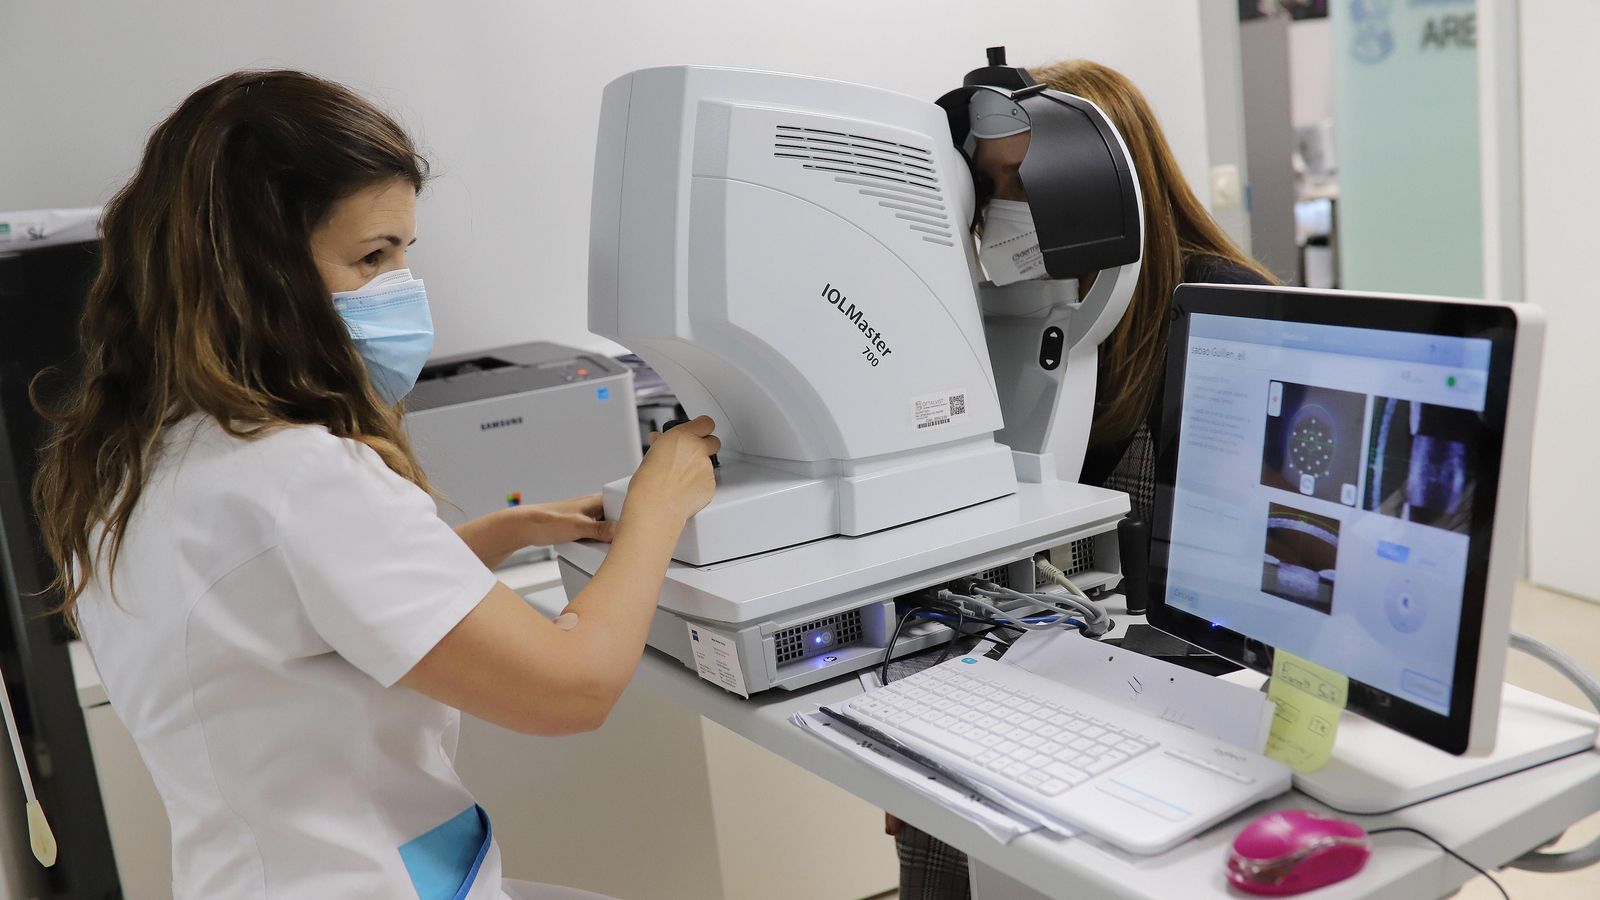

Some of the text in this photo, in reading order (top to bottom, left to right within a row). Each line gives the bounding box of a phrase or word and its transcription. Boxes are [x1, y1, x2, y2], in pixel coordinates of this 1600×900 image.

[821, 283, 892, 357] IOLMaster
[862, 346, 879, 367] 700
[481, 416, 523, 430] SAMSUNG
